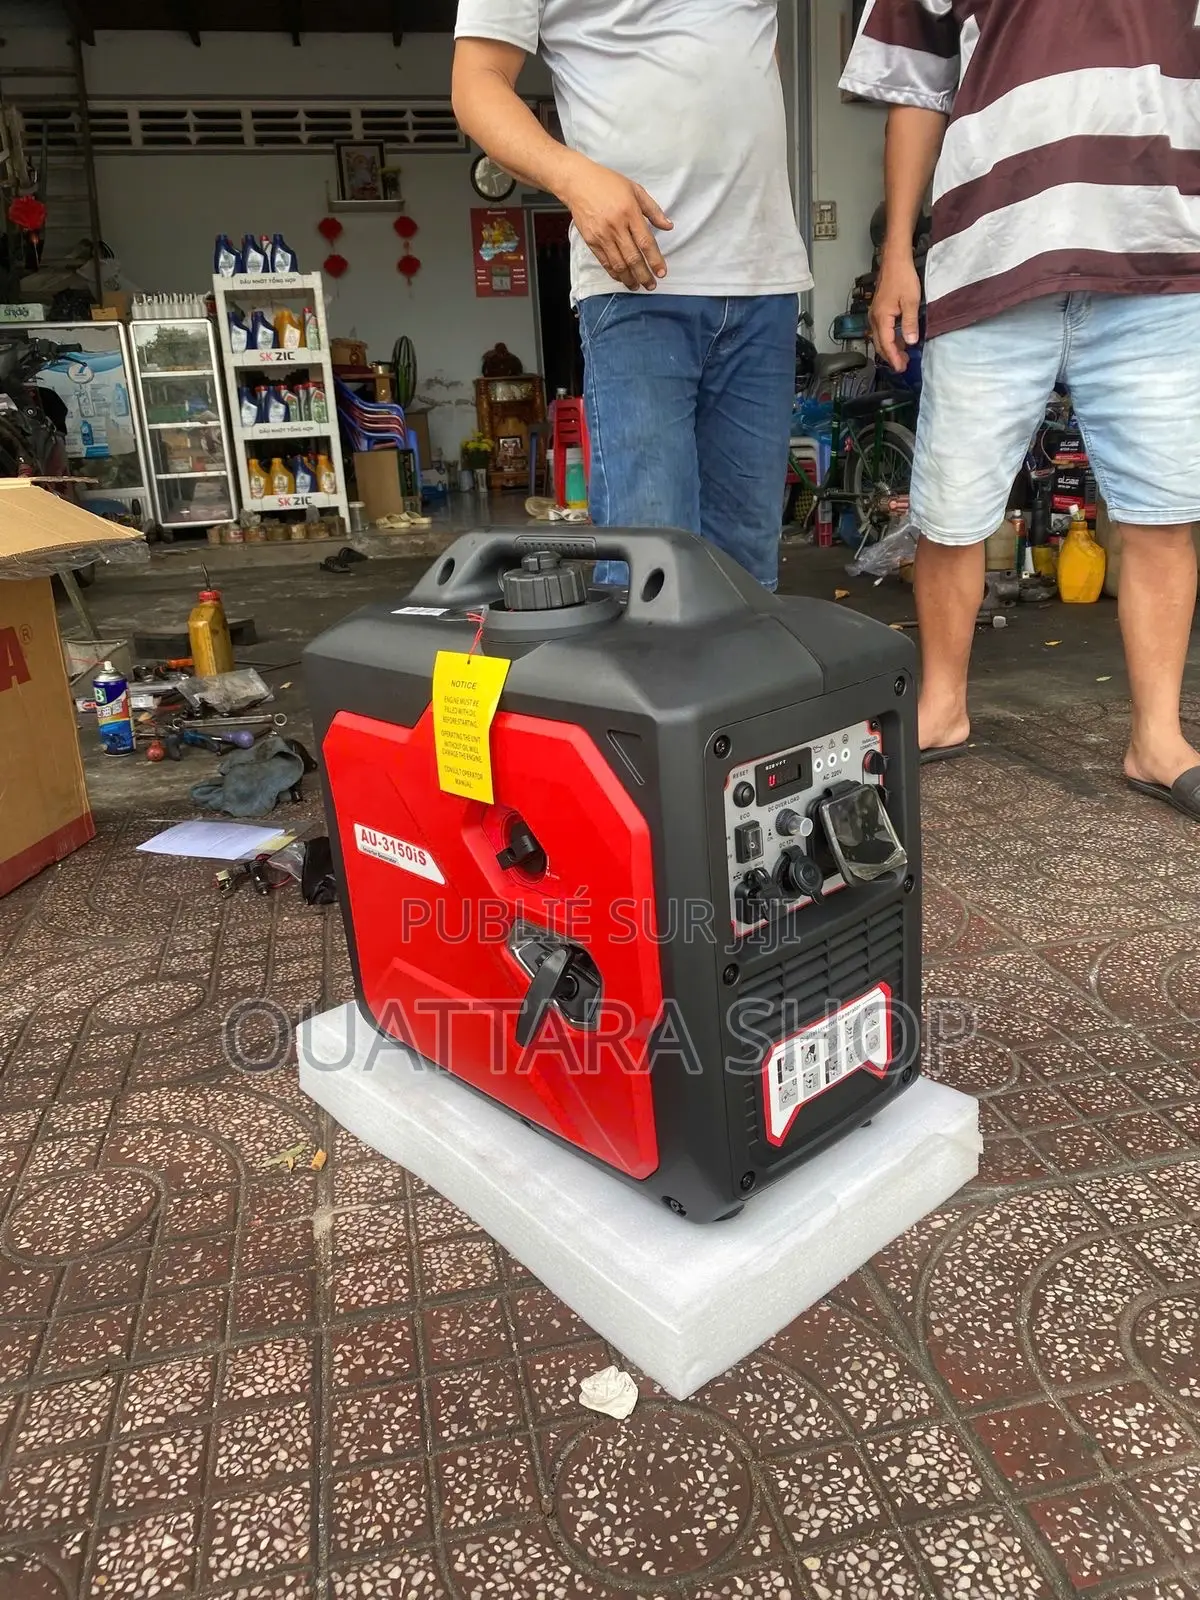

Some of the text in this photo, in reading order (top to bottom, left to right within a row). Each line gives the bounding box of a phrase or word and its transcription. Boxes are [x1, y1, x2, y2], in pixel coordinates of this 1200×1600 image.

[259, 351, 296, 361] SK ZIC
[278, 496, 312, 506] SK ZIC
[451, 680, 477, 690] NOTICE
[733, 769, 749, 780] RESET
[823, 768, 843, 781] AC 220V
[740, 812, 751, 820] ECO
[361, 828, 427, 866] AU-3150iS
